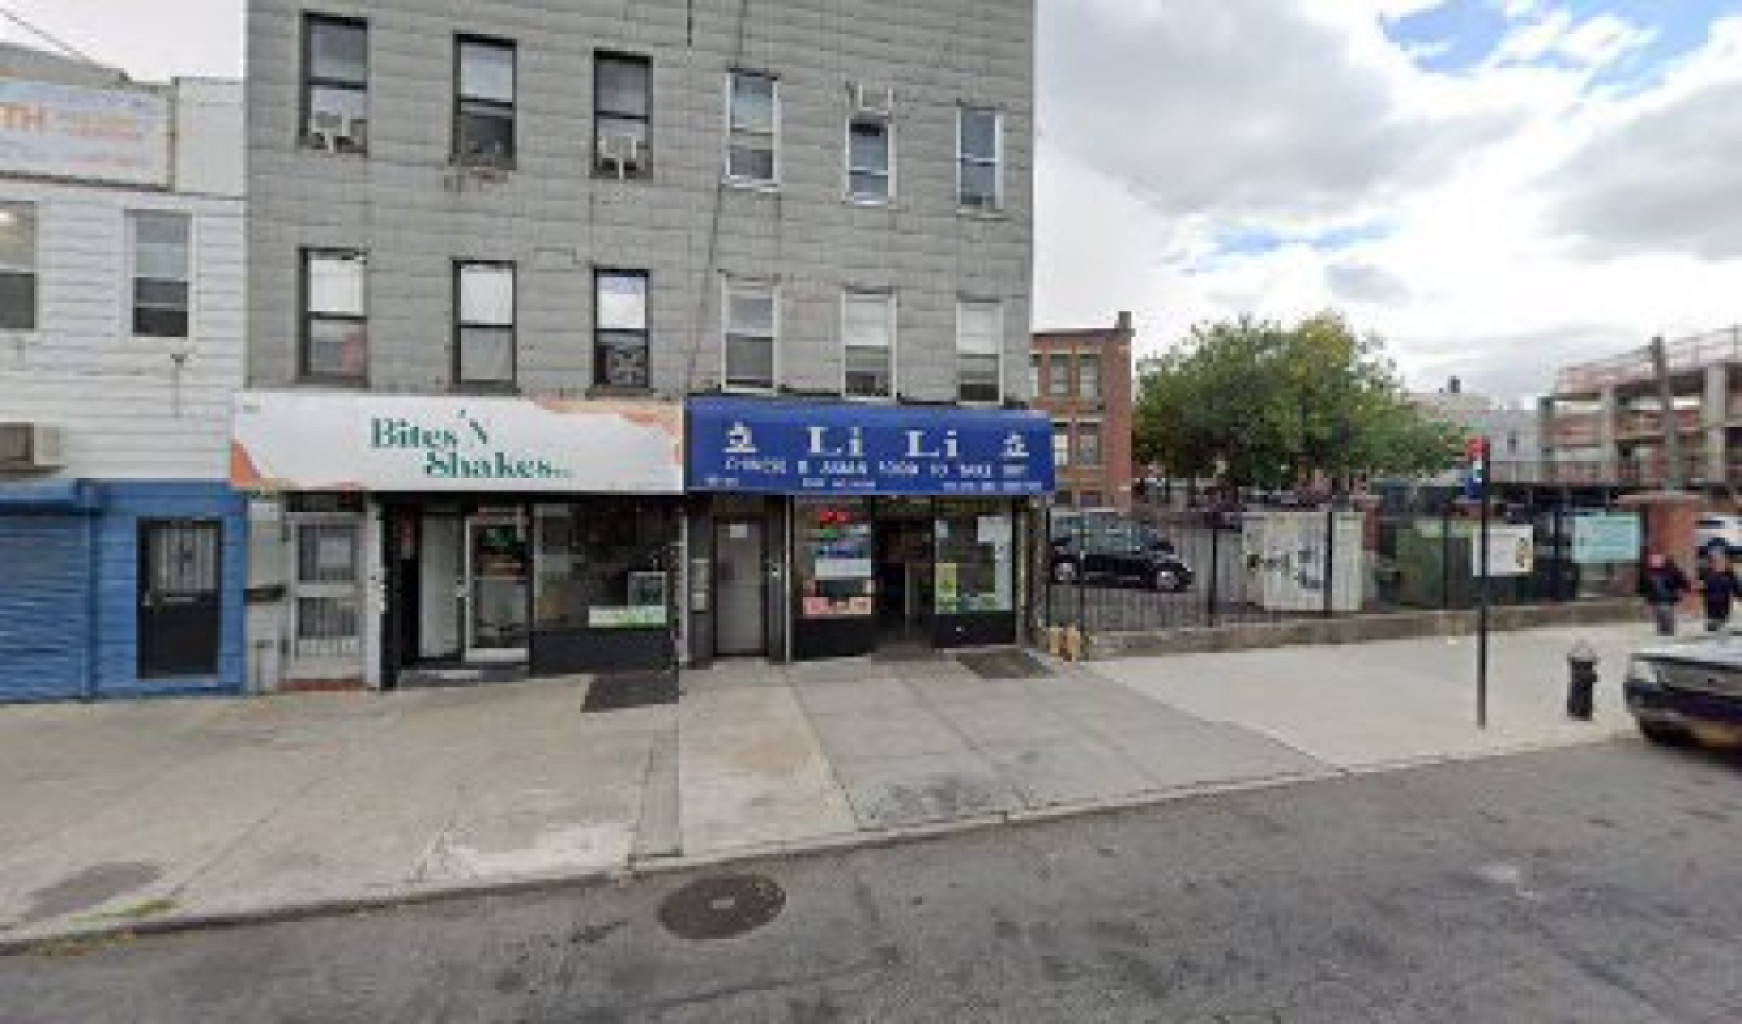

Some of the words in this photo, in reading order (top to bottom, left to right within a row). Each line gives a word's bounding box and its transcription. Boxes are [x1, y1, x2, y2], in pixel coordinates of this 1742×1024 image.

[370, 416, 458, 448] Bites
[806, 426, 863, 457] Li
[905, 430, 957, 457] Li
[424, 451, 552, 478] Shakes
